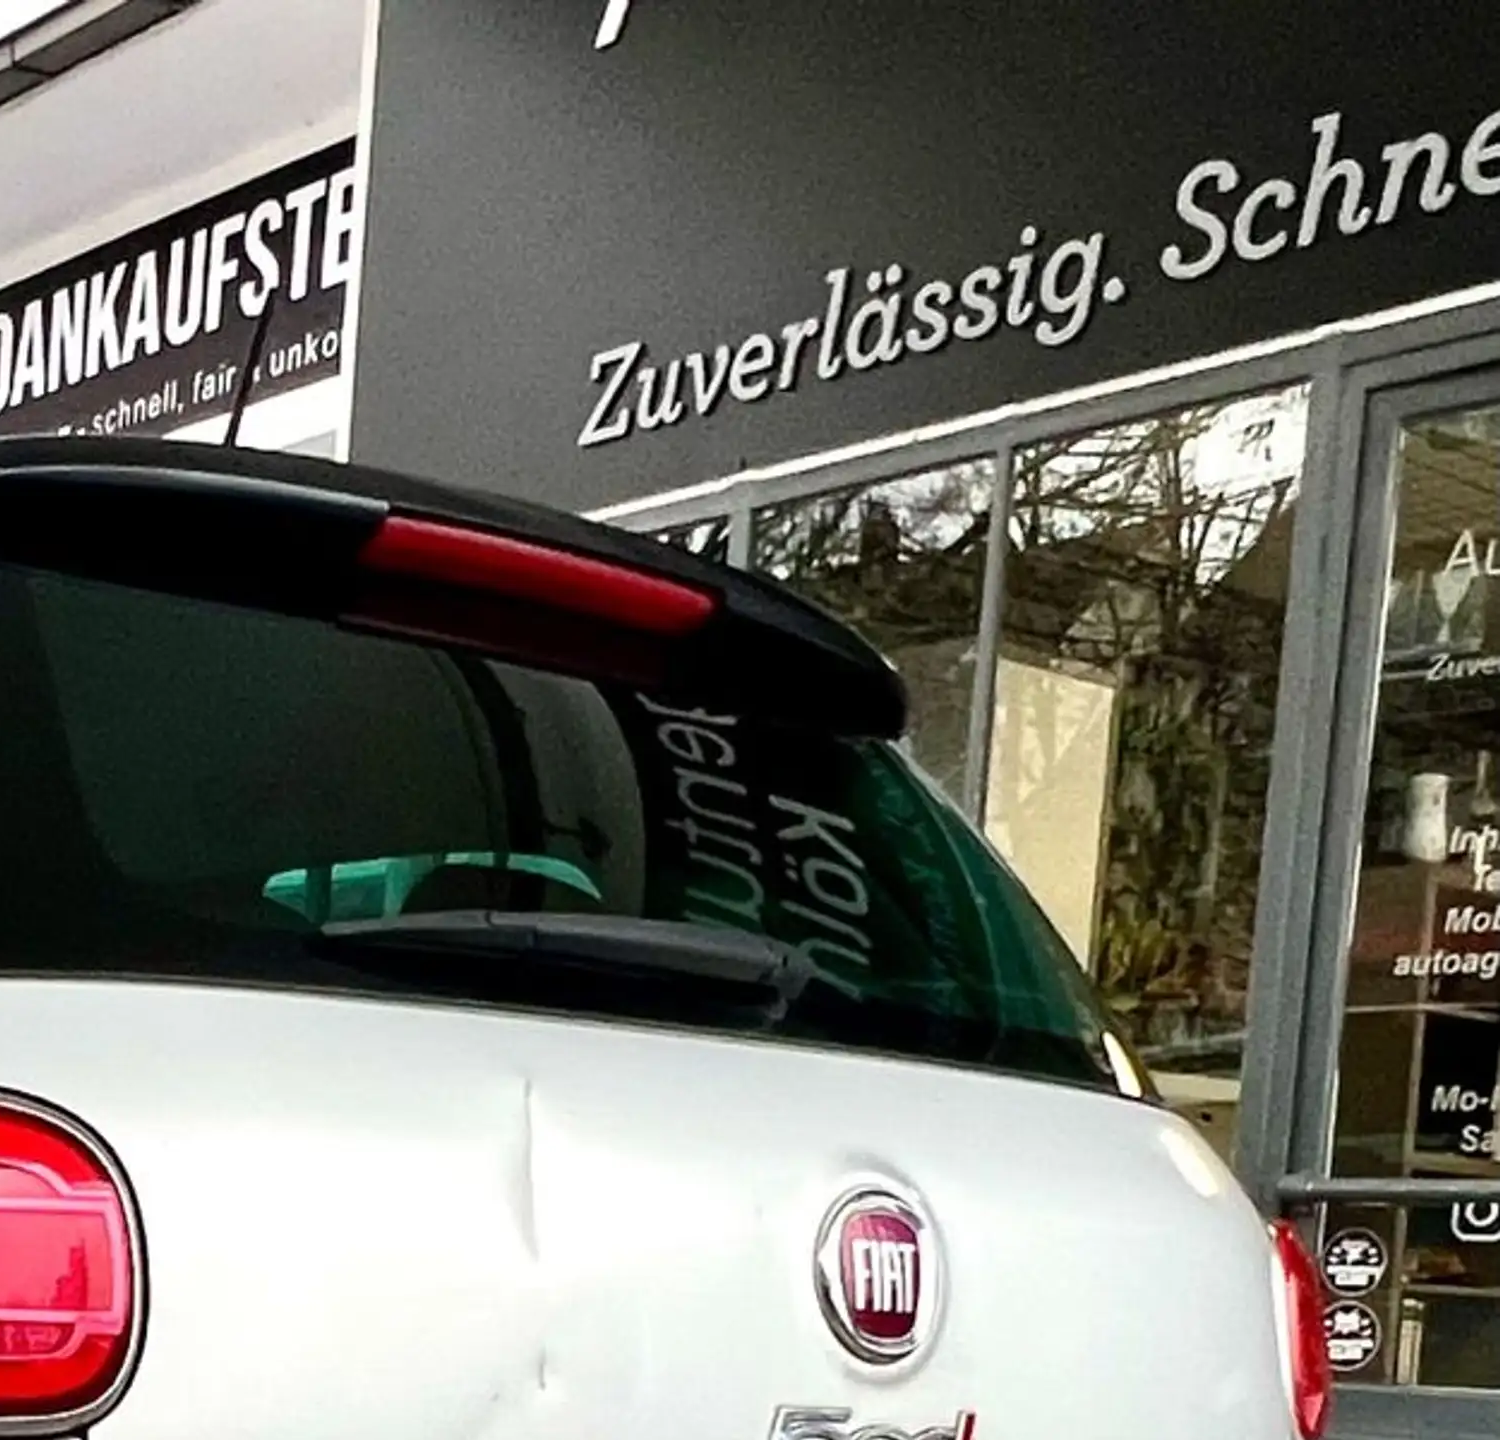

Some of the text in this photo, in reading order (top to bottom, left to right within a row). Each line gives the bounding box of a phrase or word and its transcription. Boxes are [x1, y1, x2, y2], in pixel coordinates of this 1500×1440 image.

[576, 224, 1127, 446] Zuverlässig.
[91, 329, 338, 437] schnell, fair unko
[1393, 948, 1500, 980] autoag
[851, 1238, 917, 1313] FIAT
